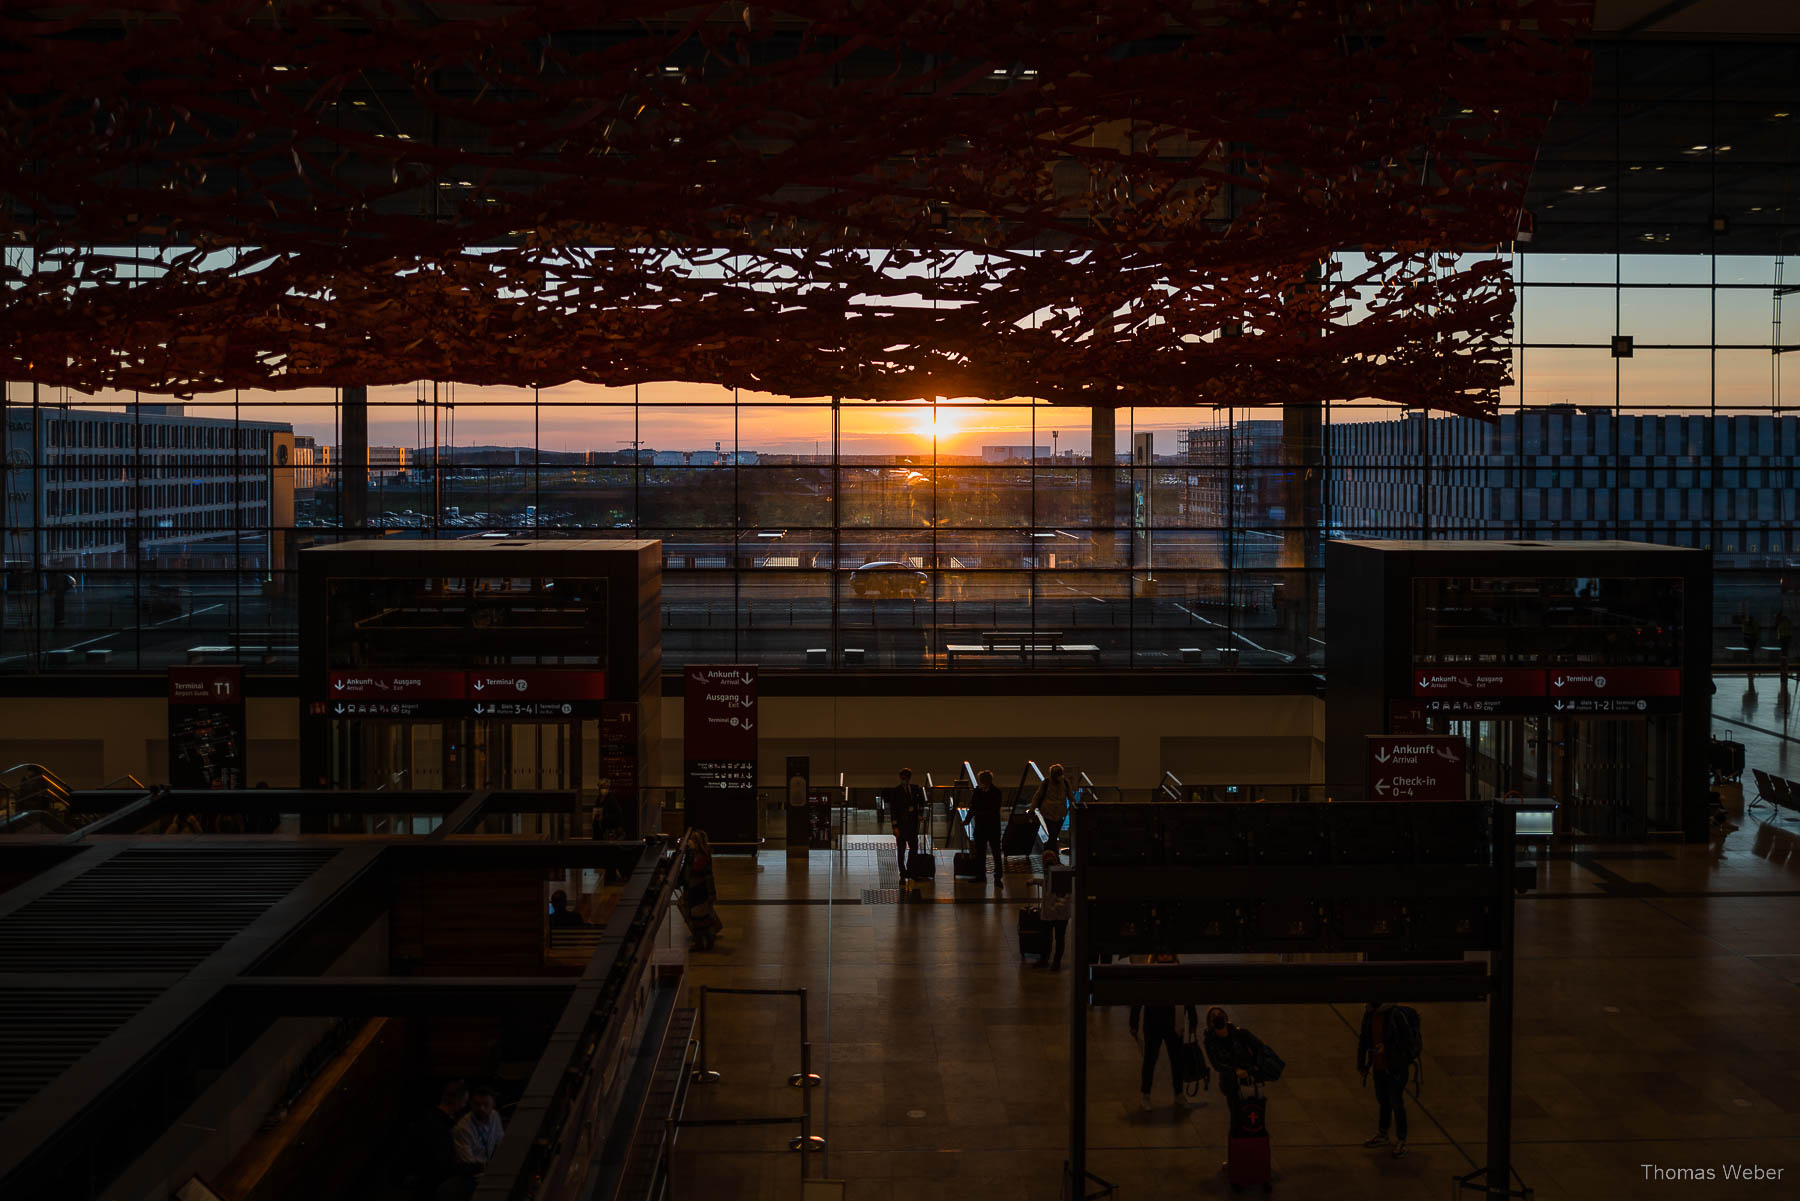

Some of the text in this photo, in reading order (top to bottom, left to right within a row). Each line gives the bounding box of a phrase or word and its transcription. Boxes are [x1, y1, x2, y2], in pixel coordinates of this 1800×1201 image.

[707, 670, 740, 678] Ankunft
[393, 678, 422, 686] Ausgang
[1476, 676, 1504, 684] Ausgang
[1566, 675, 1594, 683] Terminal
[214, 682, 231, 695] T1
[706, 693, 739, 702] Ausgang
[1392, 744, 1435, 754] Ankunft
[1392, 755, 1418, 764] Arrival
[1392, 776, 1436, 786] Check-in
